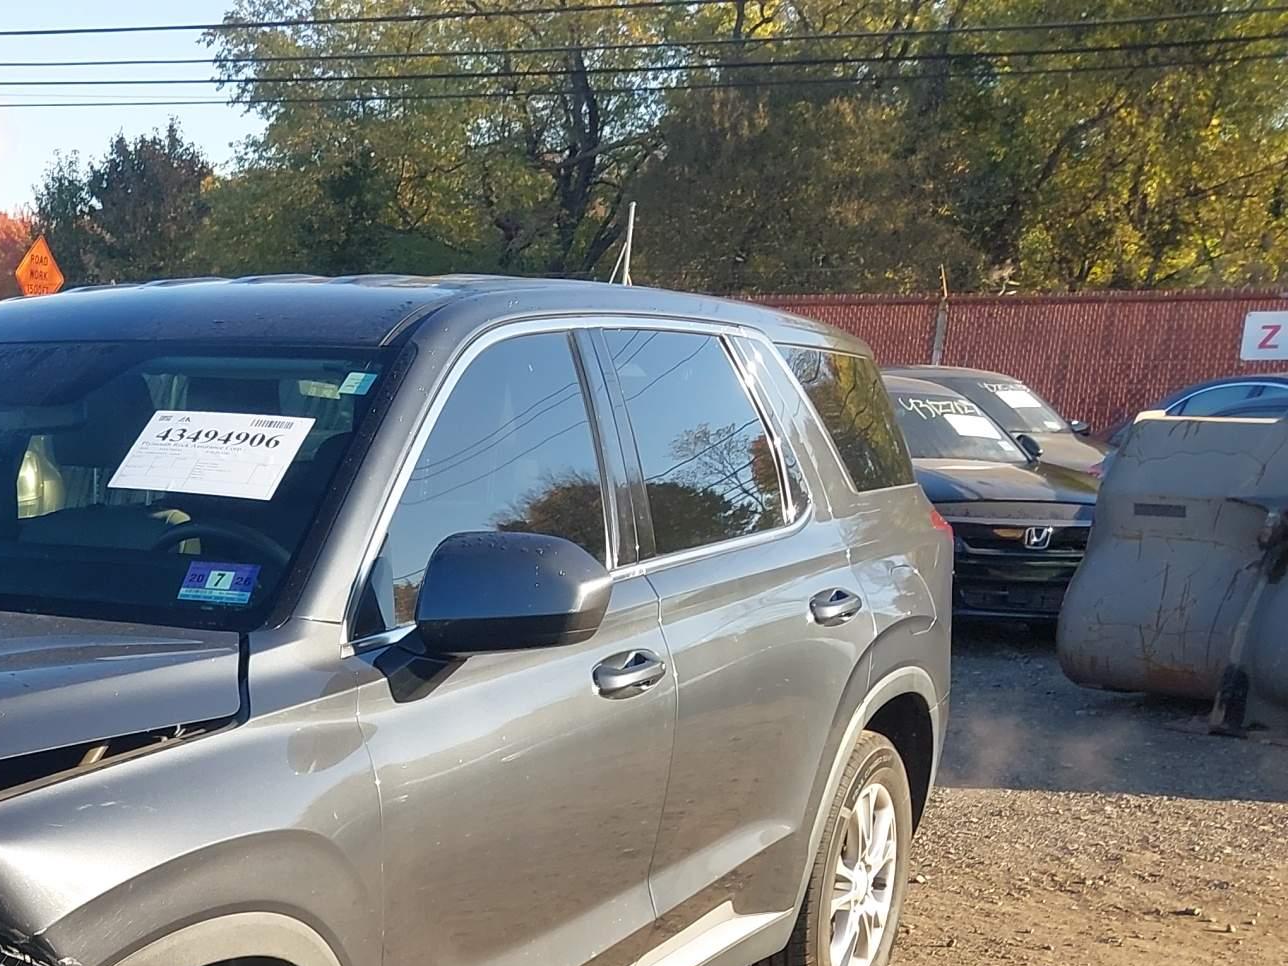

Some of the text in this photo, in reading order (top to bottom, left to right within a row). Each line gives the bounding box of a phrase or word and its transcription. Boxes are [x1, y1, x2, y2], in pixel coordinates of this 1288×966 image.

[30, 254, 49, 266] ROAD
[30, 269, 49, 280] WORK
[1258, 325, 1282, 349] Z
[156, 428, 285, 449] 43494906
[189, 573, 205, 583] 20
[214, 573, 226, 587] 7
